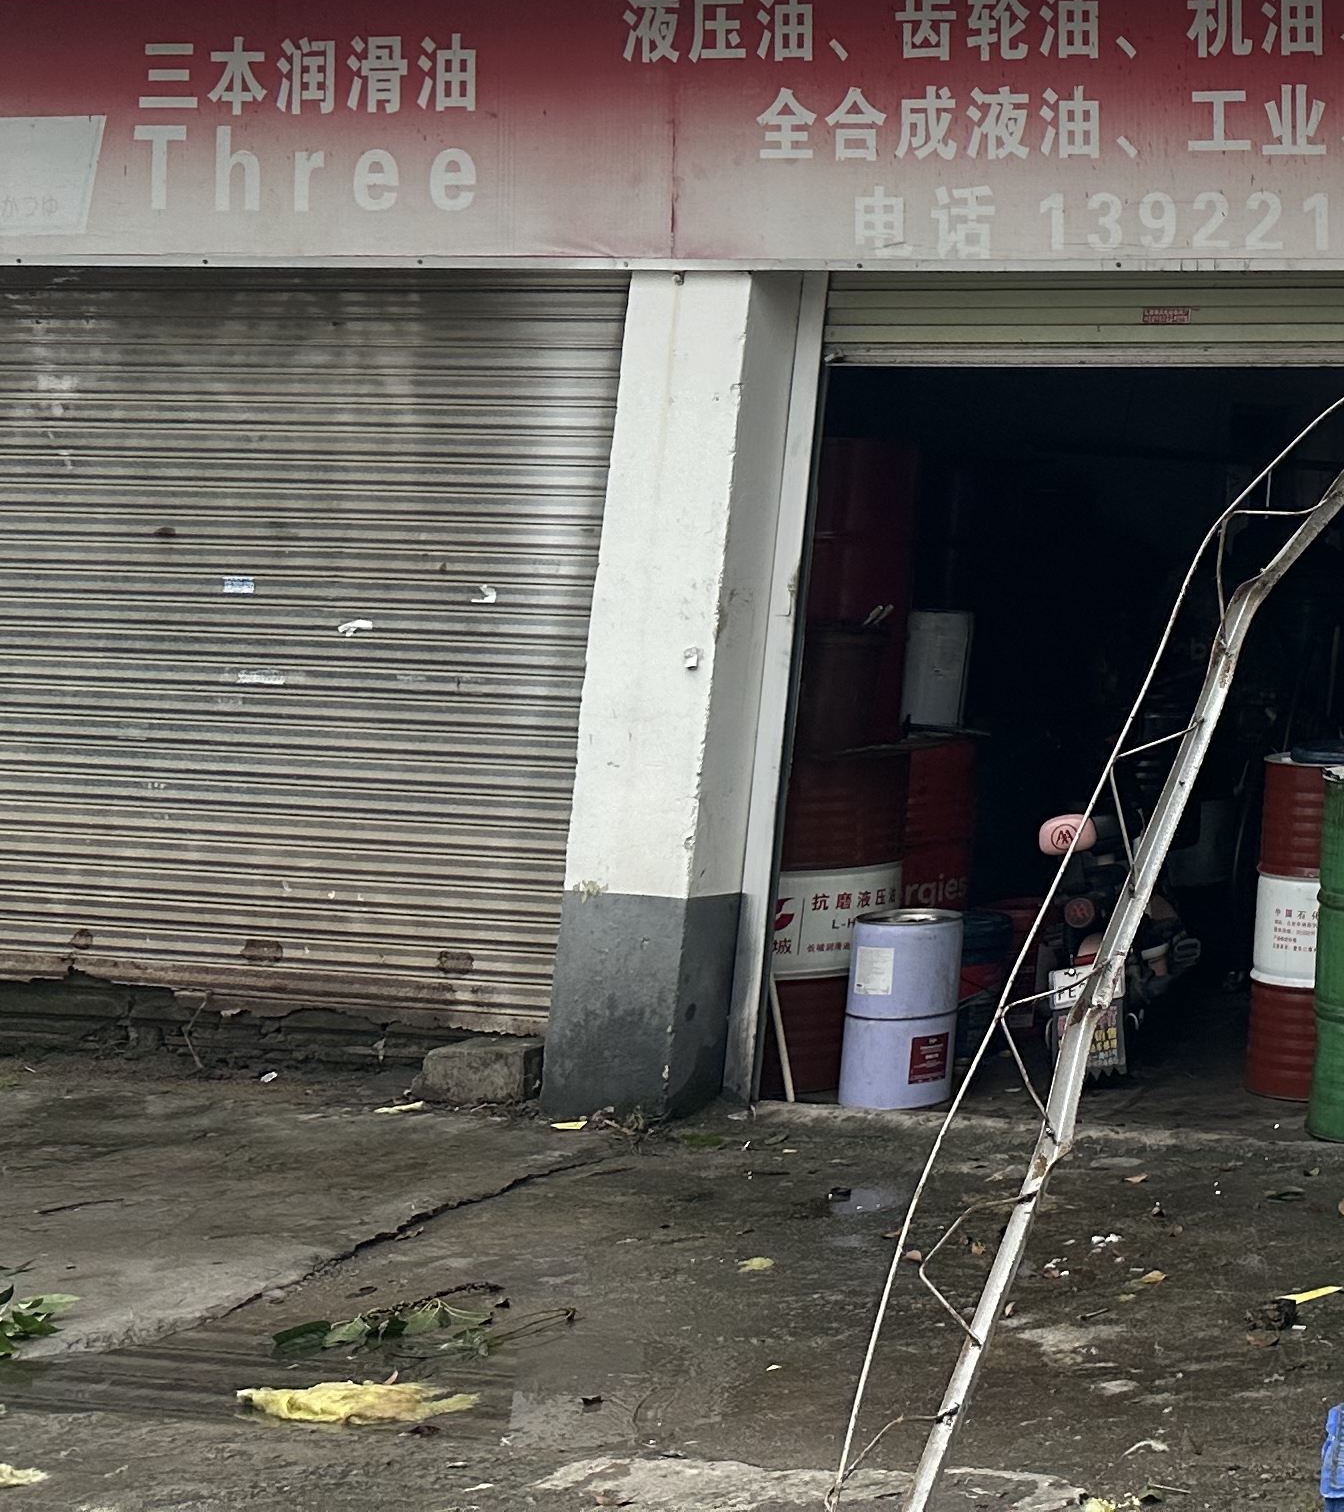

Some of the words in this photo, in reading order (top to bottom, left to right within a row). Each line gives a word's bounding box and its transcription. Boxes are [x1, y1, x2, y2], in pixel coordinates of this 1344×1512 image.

[137, 33, 478, 115] 三本润滑油
[133, 124, 478, 212] Three
[853, 184, 997, 259] 电话
